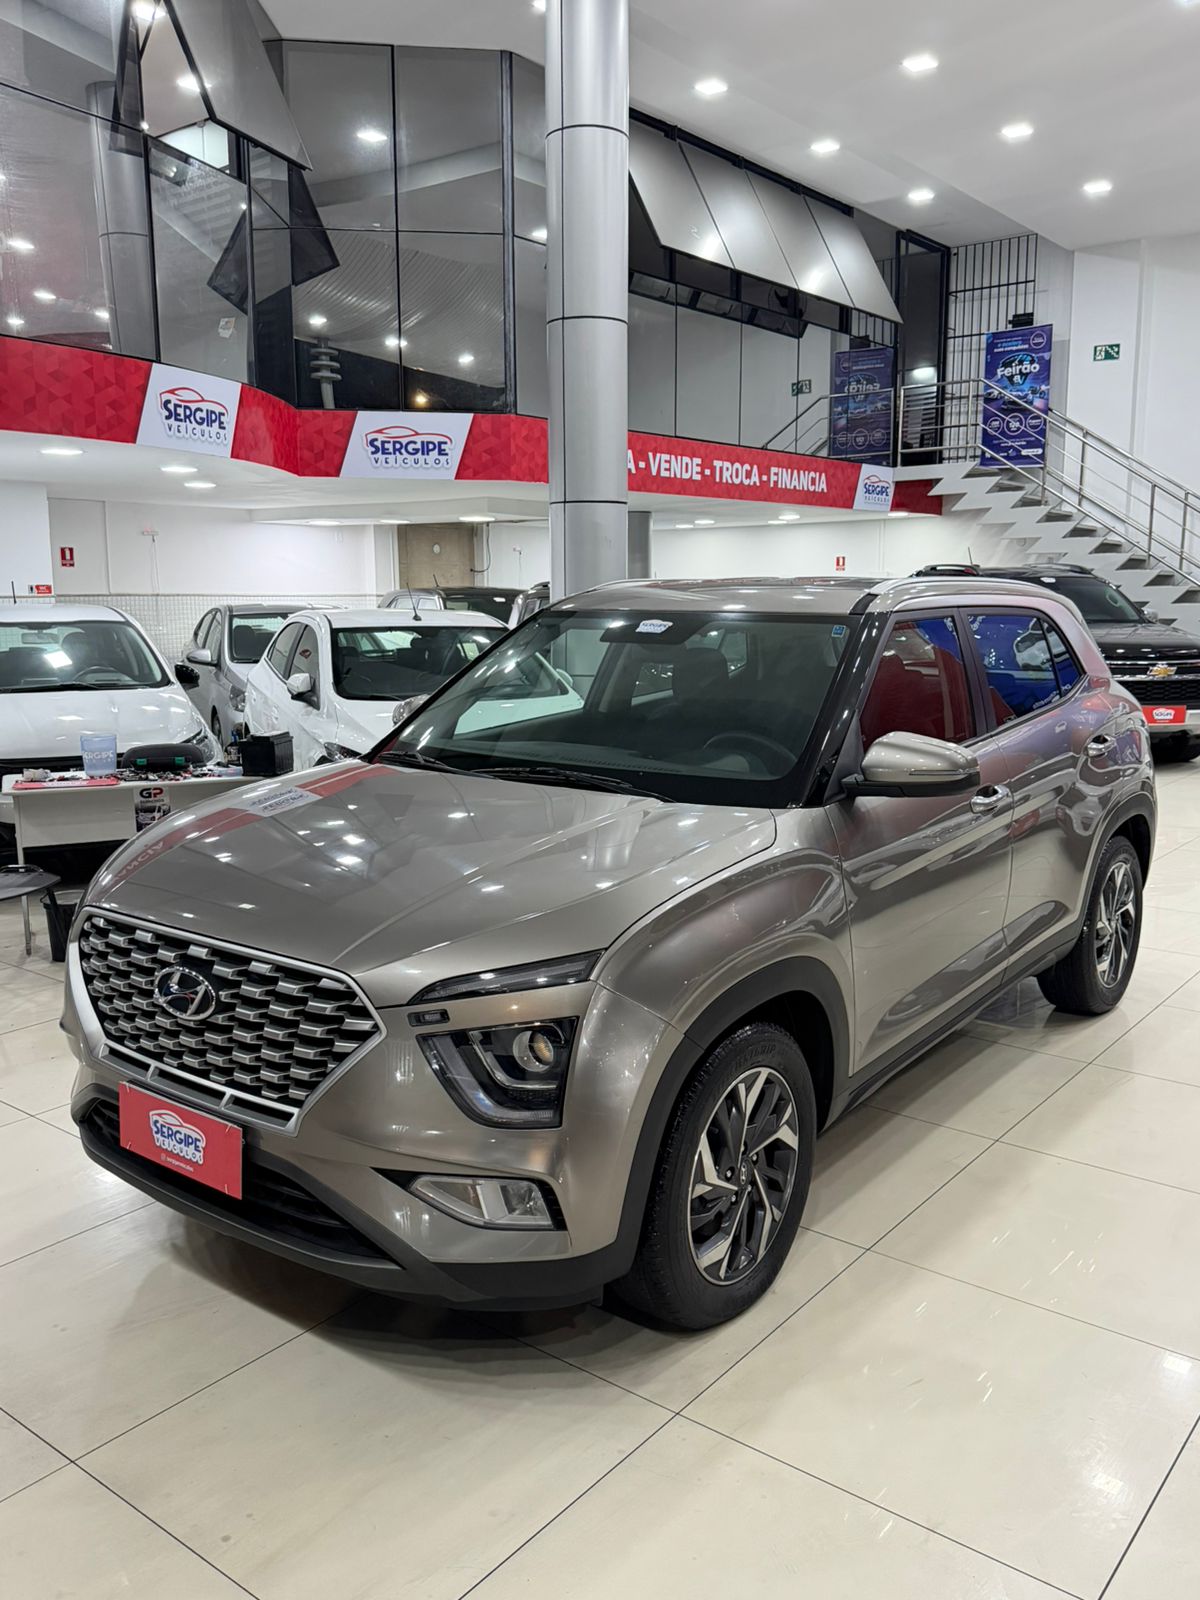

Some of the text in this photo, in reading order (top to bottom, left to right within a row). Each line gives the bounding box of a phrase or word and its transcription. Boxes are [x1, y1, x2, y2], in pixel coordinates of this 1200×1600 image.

[997, 362, 1040, 379] Feirão
[163, 399, 226, 430] SERGIPE
[167, 424, 227, 441] VEÍCULOS
[369, 438, 449, 456] SERGIPE
[373, 456, 450, 465] VEÍCULOS
[648, 452, 702, 481] VENDE
[713, 459, 760, 487] TROCA
[770, 466, 828, 493] FINANCIA
[864, 482, 890, 497] SERGIPE
[139, 787, 164, 799] GP
[153, 1119, 202, 1153] SERGIPE
